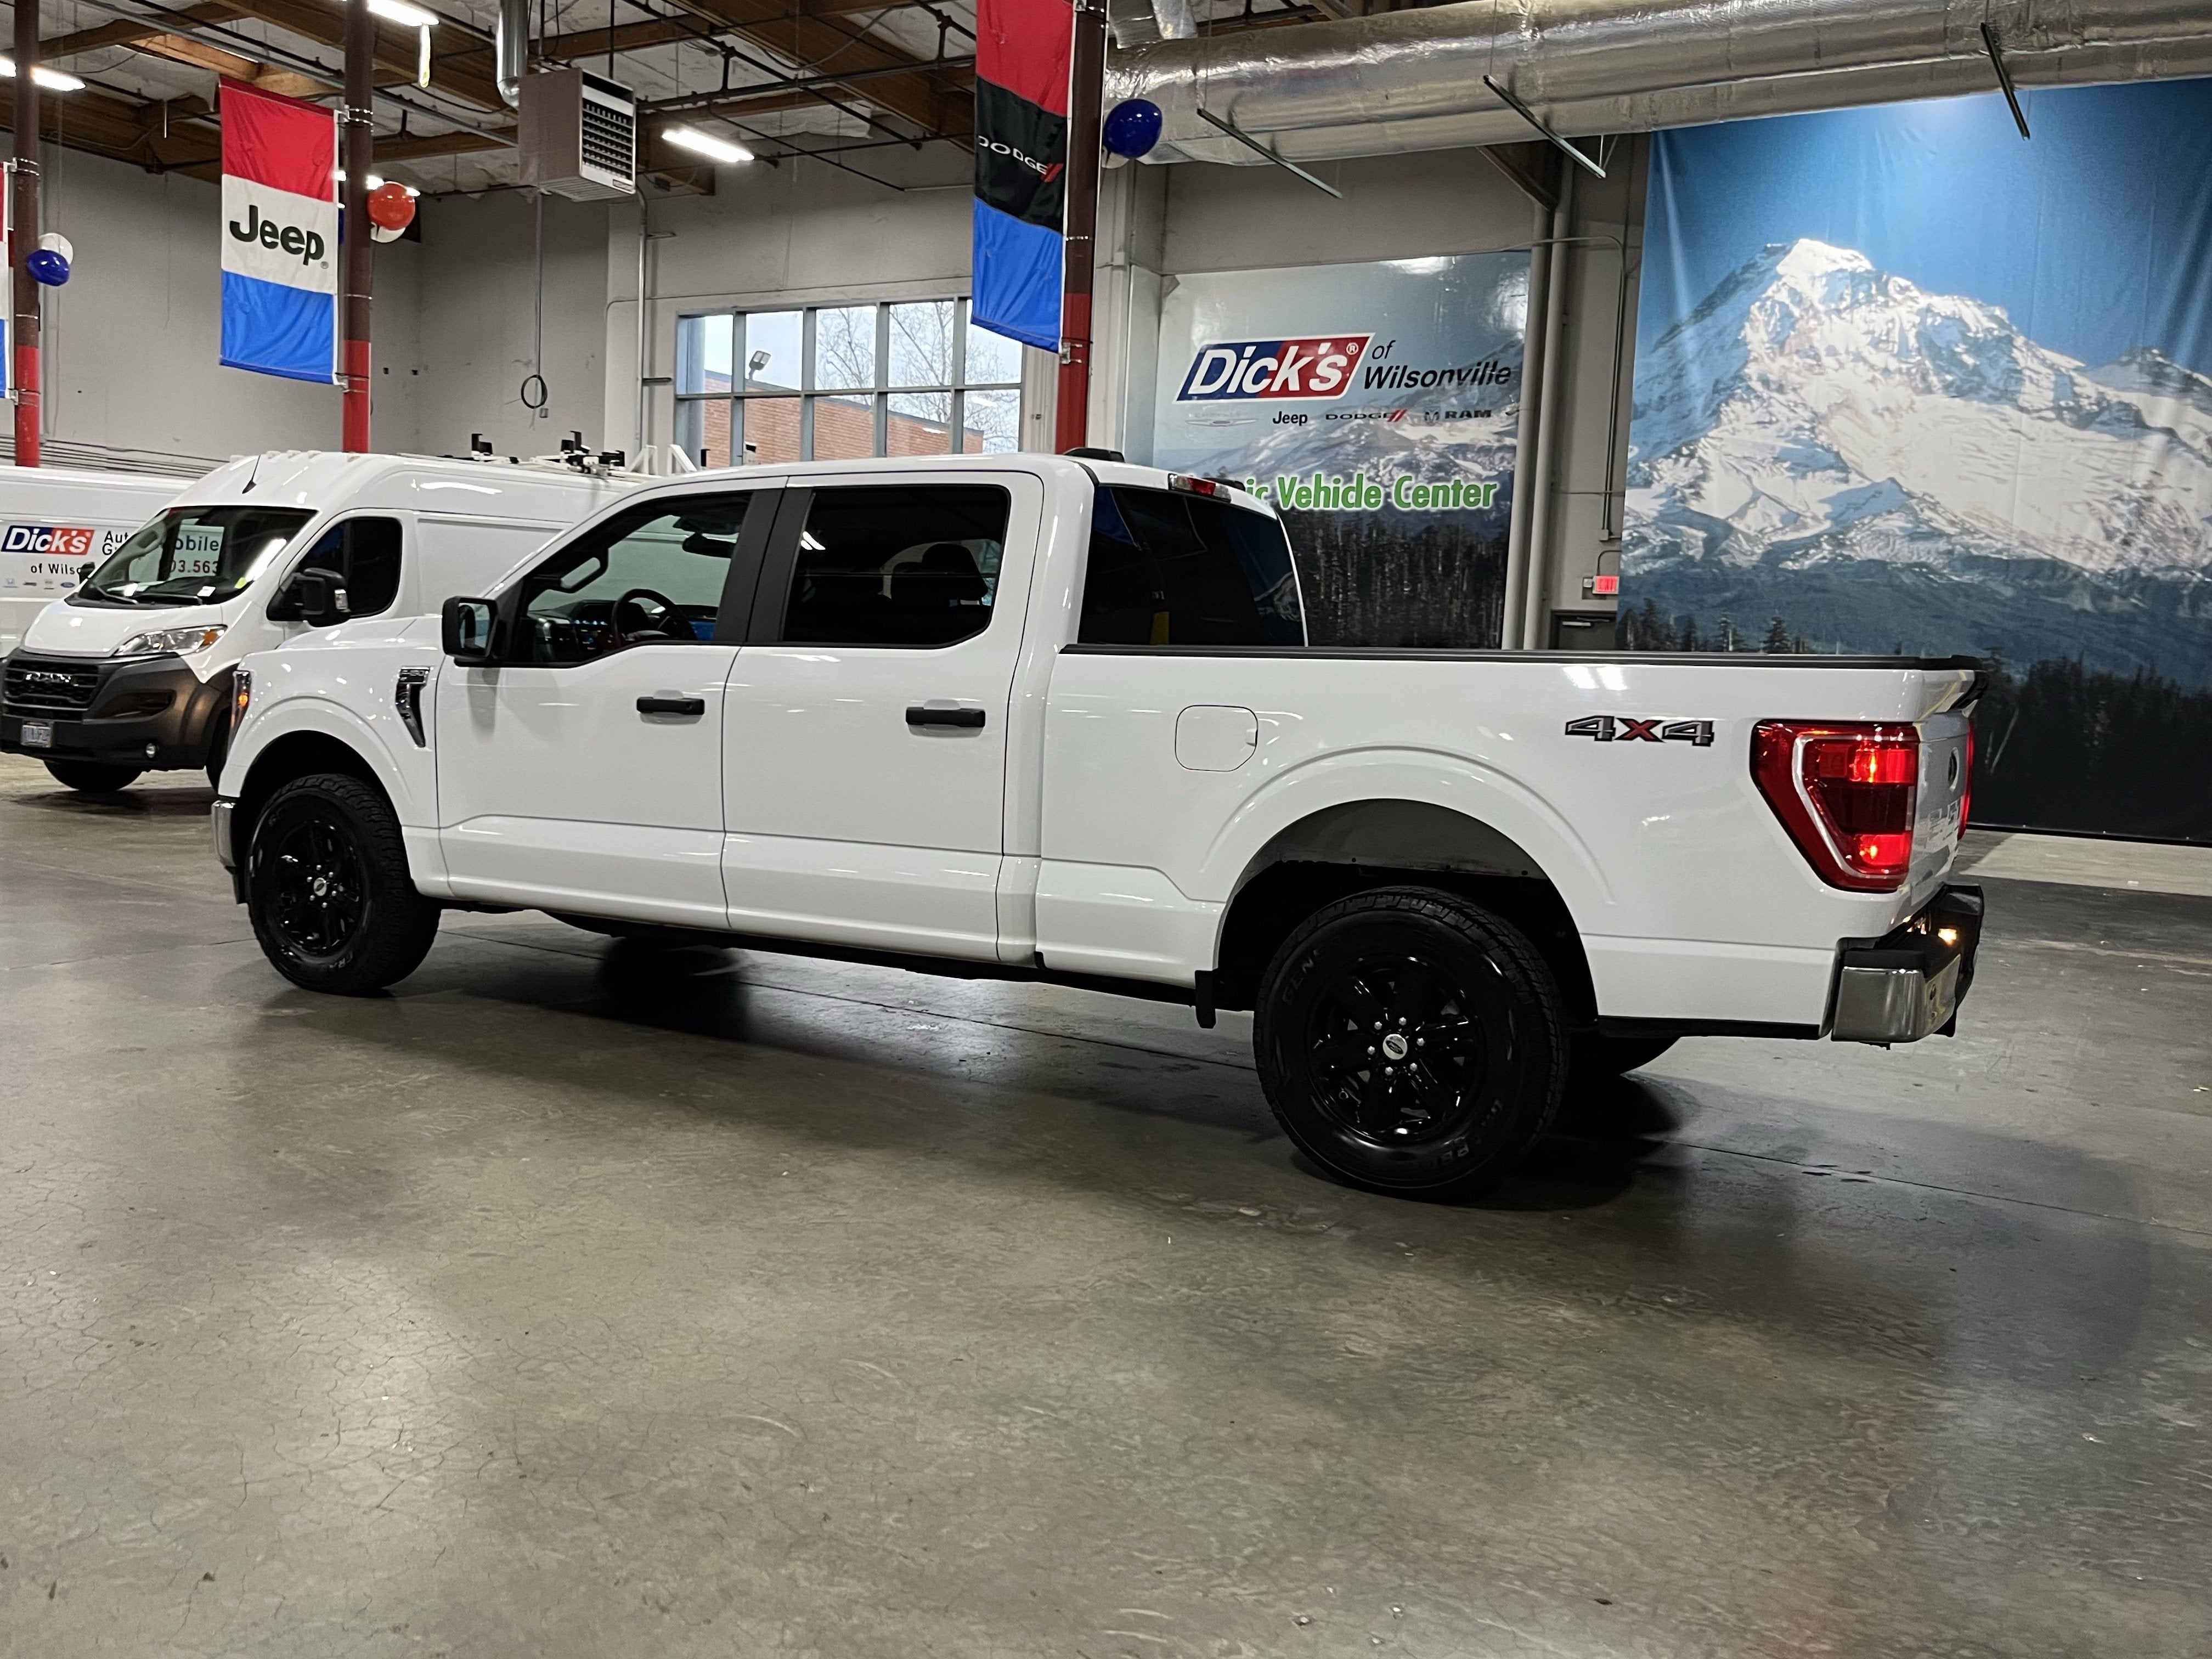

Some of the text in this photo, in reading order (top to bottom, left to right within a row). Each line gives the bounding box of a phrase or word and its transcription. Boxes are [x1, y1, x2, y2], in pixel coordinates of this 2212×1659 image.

[229, 205, 325, 266] Jeep
[1187, 340, 1396, 394] Dick's of
[1364, 361, 1511, 389] Wilsonville
[1272, 411, 1308, 426] Jeep
[1444, 410, 1492, 419] RAM
[1278, 473, 1382, 508] Vehicle
[1394, 476, 1497, 508] Center
[5, 527, 87, 553] Dick's
[31, 563, 42, 573] of
